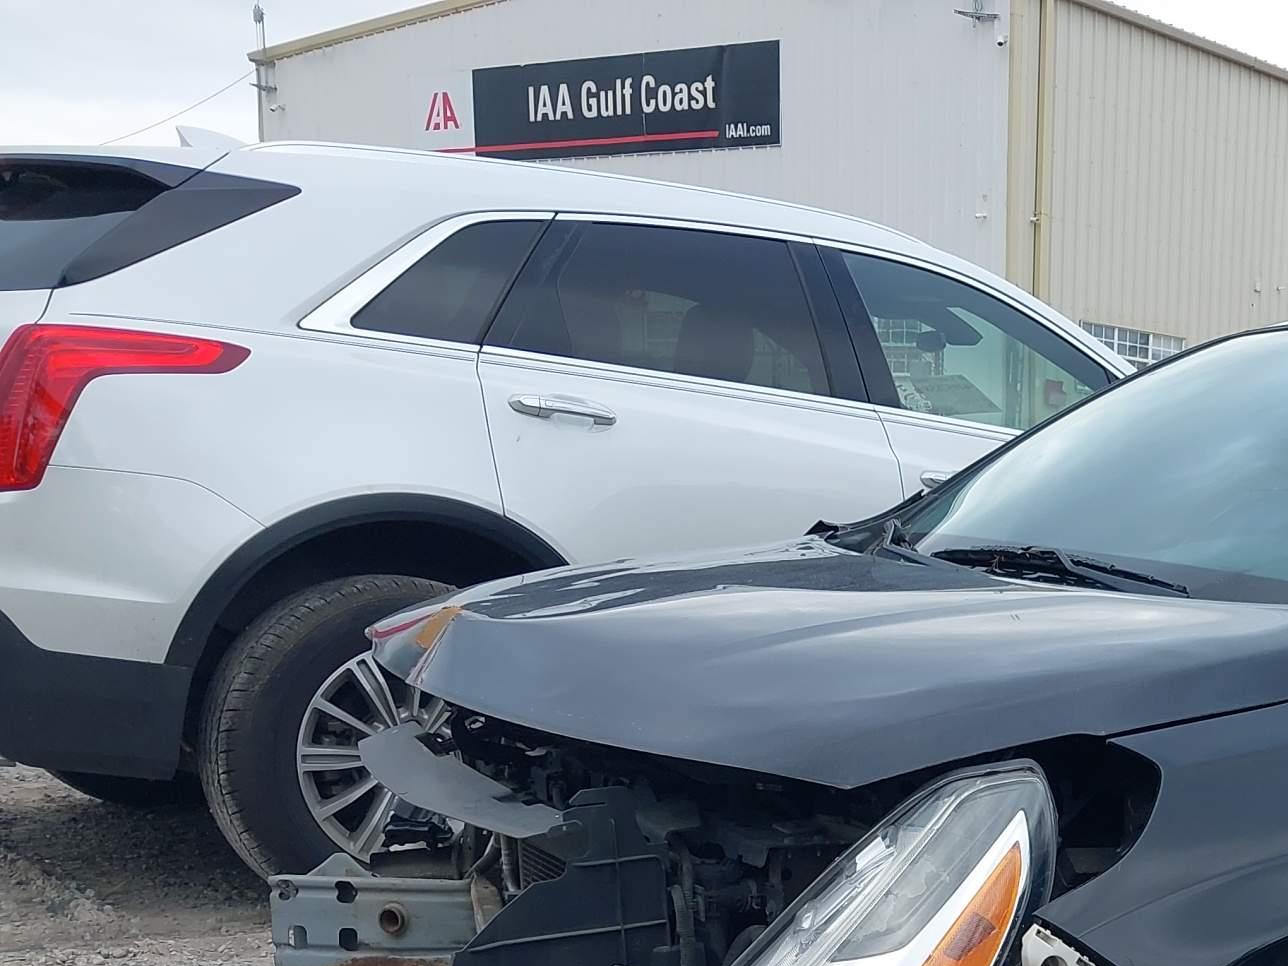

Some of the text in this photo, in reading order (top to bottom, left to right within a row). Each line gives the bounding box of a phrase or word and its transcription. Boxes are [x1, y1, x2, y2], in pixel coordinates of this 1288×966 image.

[528, 74, 716, 122] IAA Gulf Coast
[725, 122, 771, 138] IAAI.com
